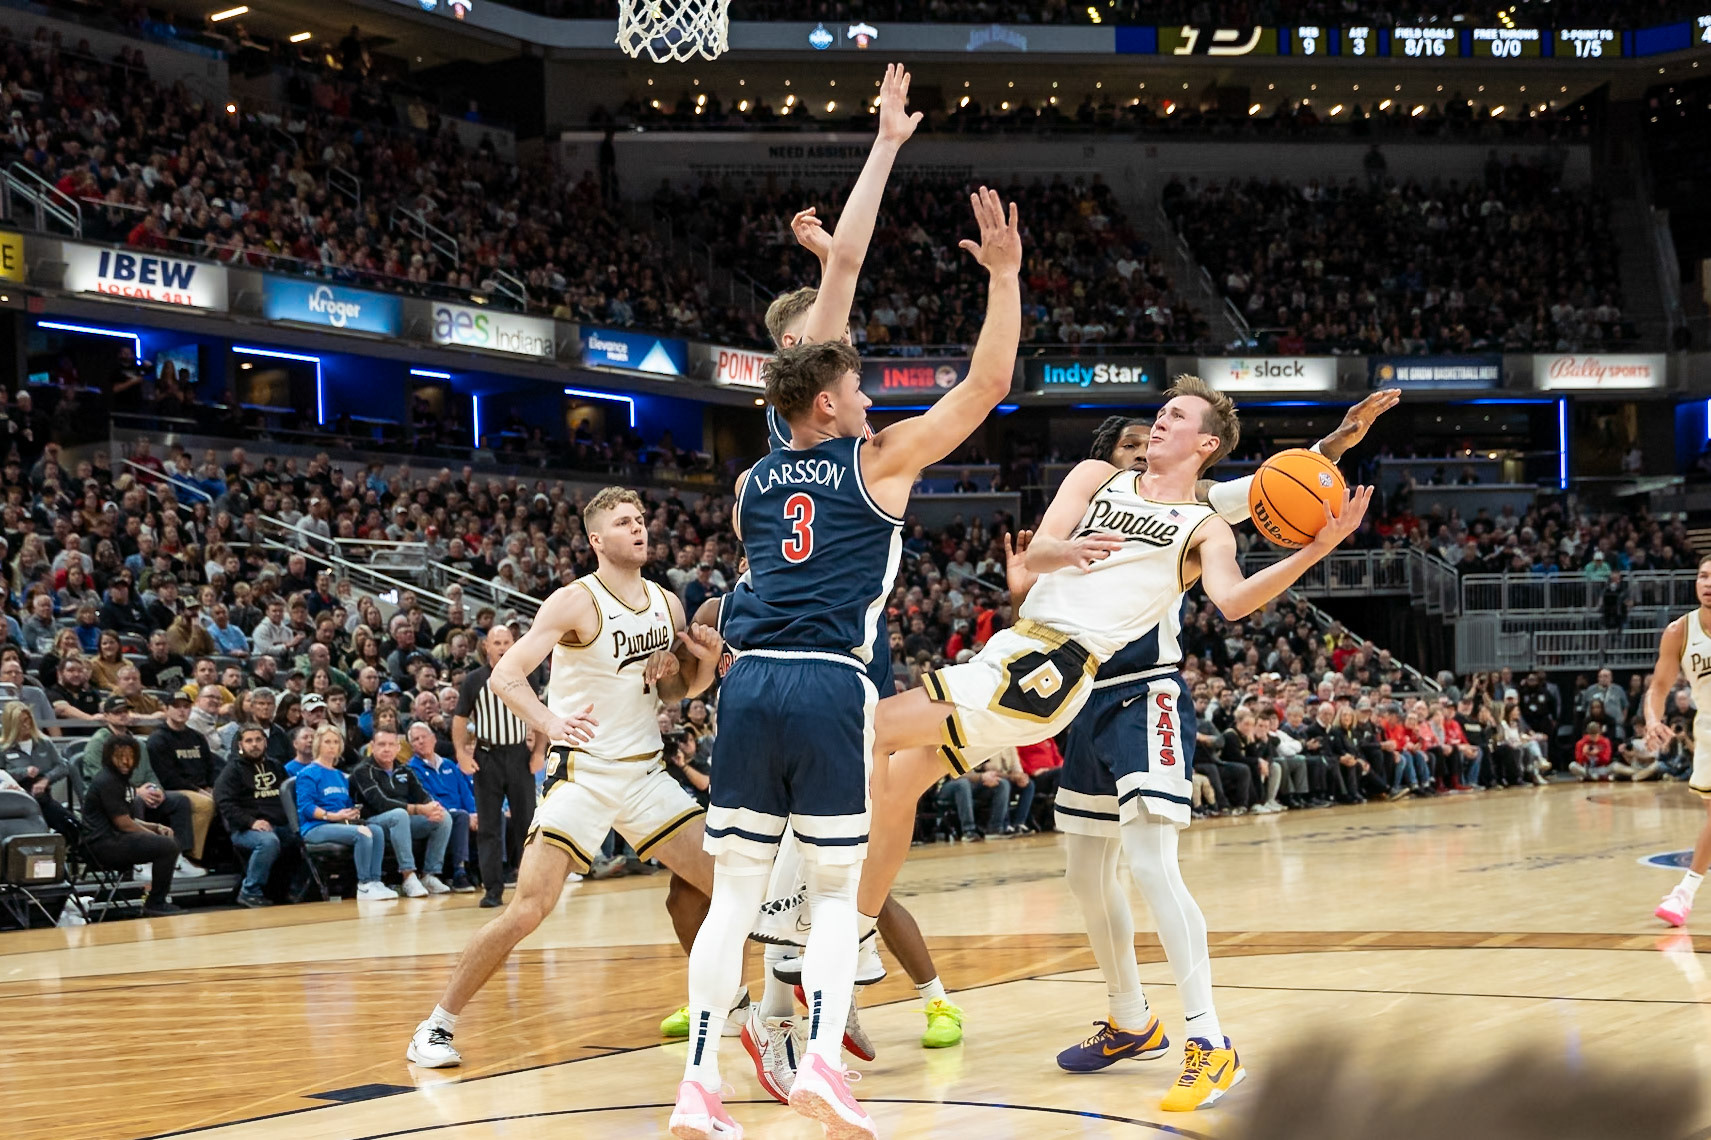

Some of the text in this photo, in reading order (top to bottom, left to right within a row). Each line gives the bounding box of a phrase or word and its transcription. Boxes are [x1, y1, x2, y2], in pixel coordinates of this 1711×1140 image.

[1395, 27, 1455, 40] FIELD GOALS
[1473, 29, 1539, 41] FREE THROWS
[1303, 38, 1316, 55] 9
[1353, 38, 1366, 55] 3
[1404, 38, 1446, 57] 8/16
[1491, 39, 1522, 58] 0/0
[1574, 40, 1602, 58] 1/5
[98, 251, 197, 289] IBEW
[98, 282, 155, 301] LOCAL
[309, 285, 360, 327] Kroger
[435, 308, 553, 357] aes Indiana
[588, 336, 628, 354] Elevance
[1254, 360, 1304, 377] slack
[1550, 356, 1651, 384] Bally SPORTS
[754, 459, 846, 494] LARSSON
[781, 492, 815, 563] 3
[1084, 500, 1179, 546] Purdue
[612, 625, 670, 659] Purdue
[1156, 692, 1176, 767] CATS
